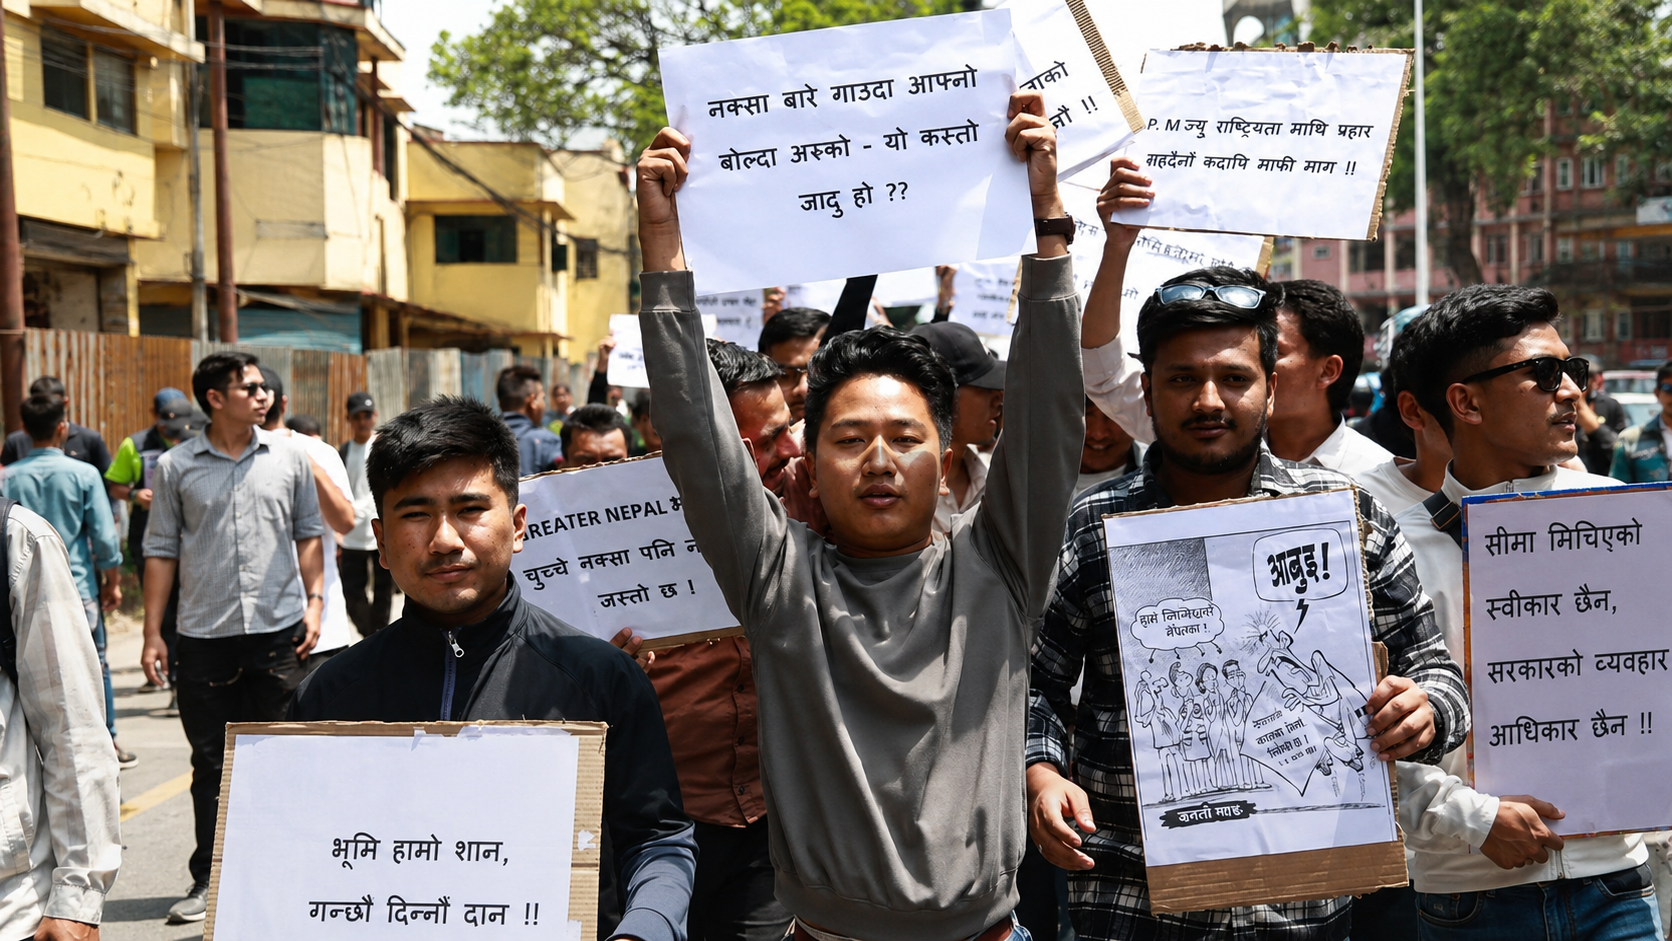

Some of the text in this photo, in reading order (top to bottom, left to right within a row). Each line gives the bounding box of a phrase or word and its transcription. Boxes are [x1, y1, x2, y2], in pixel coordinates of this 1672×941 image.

[707, 63, 978, 119] नक्सा बारे गाउदा आफ्नो
[717, 147, 778, 171] बोल्दा
[882, 126, 909, 151] यो
[918, 118, 980, 147] कस्तो
[1289, 118, 1330, 137] माथि
[1337, 124, 1375, 140] प्रहार
[1203, 153, 1251, 171] कदापि
[1257, 155, 1298, 173] माफी
[1303, 160, 1338, 174] माग
[1344, 160, 1357, 176] !!
[797, 181, 909, 219] जादु हो ??
[523, 509, 602, 542] REATER
[604, 499, 668, 523] NEPAL
[1484, 517, 1643, 557] सीमा मिचिएको
[522, 556, 569, 591] चुच्चे
[577, 549, 631, 570] नक्सा
[638, 538, 676, 561] पनि
[597, 579, 696, 608] जस्तो छ !
[1485, 582, 1617, 621] स्वीकार छैन,
[1486, 648, 1670, 684] सरकारको व्यवहार
[1488, 708, 1652, 747] आधिकार छैन !!
[331, 831, 382, 871] भूमि
[454, 840, 509, 867] शान,
[463, 903, 510, 928] दान
[524, 902, 539, 926] !!
